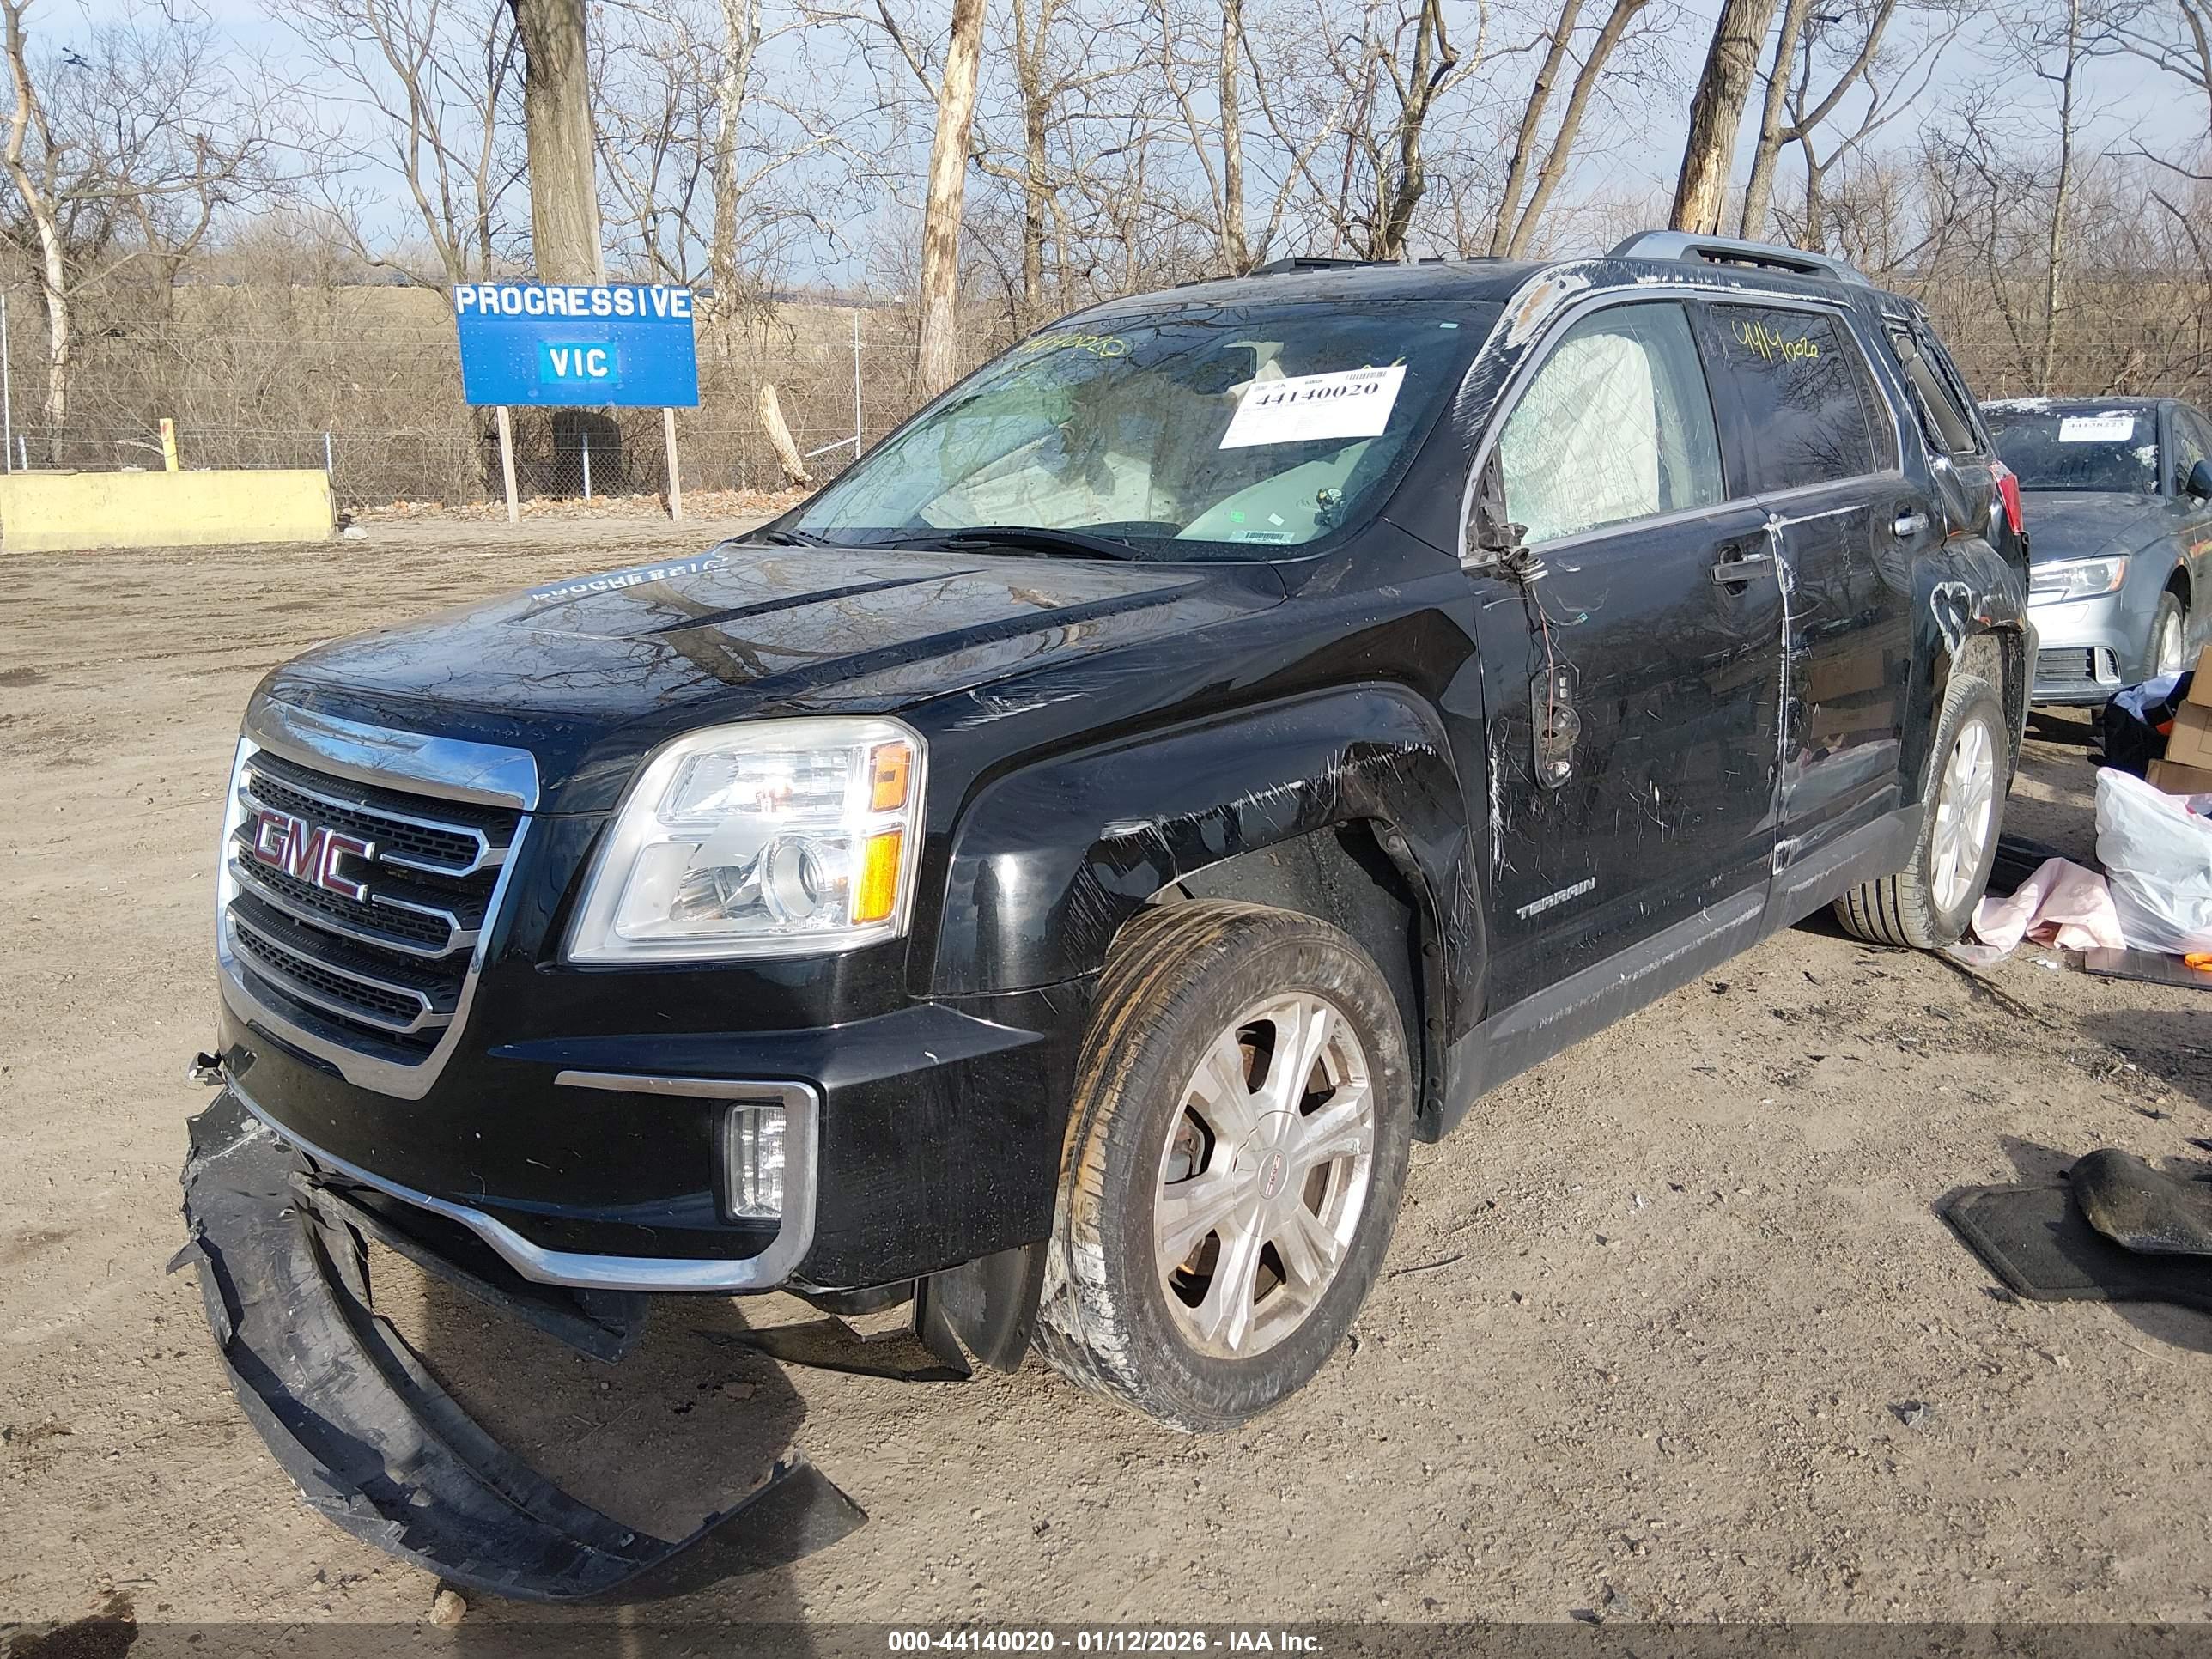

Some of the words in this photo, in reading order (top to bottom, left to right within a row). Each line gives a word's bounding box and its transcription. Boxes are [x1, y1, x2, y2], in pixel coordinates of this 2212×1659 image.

[456, 287, 691, 318] PROGRESSIVE
[550, 349, 608, 378] VIC
[1255, 381, 1379, 406] 44140020
[254, 806, 375, 904] GMC
[1516, 876, 1595, 921] TERRAIN
